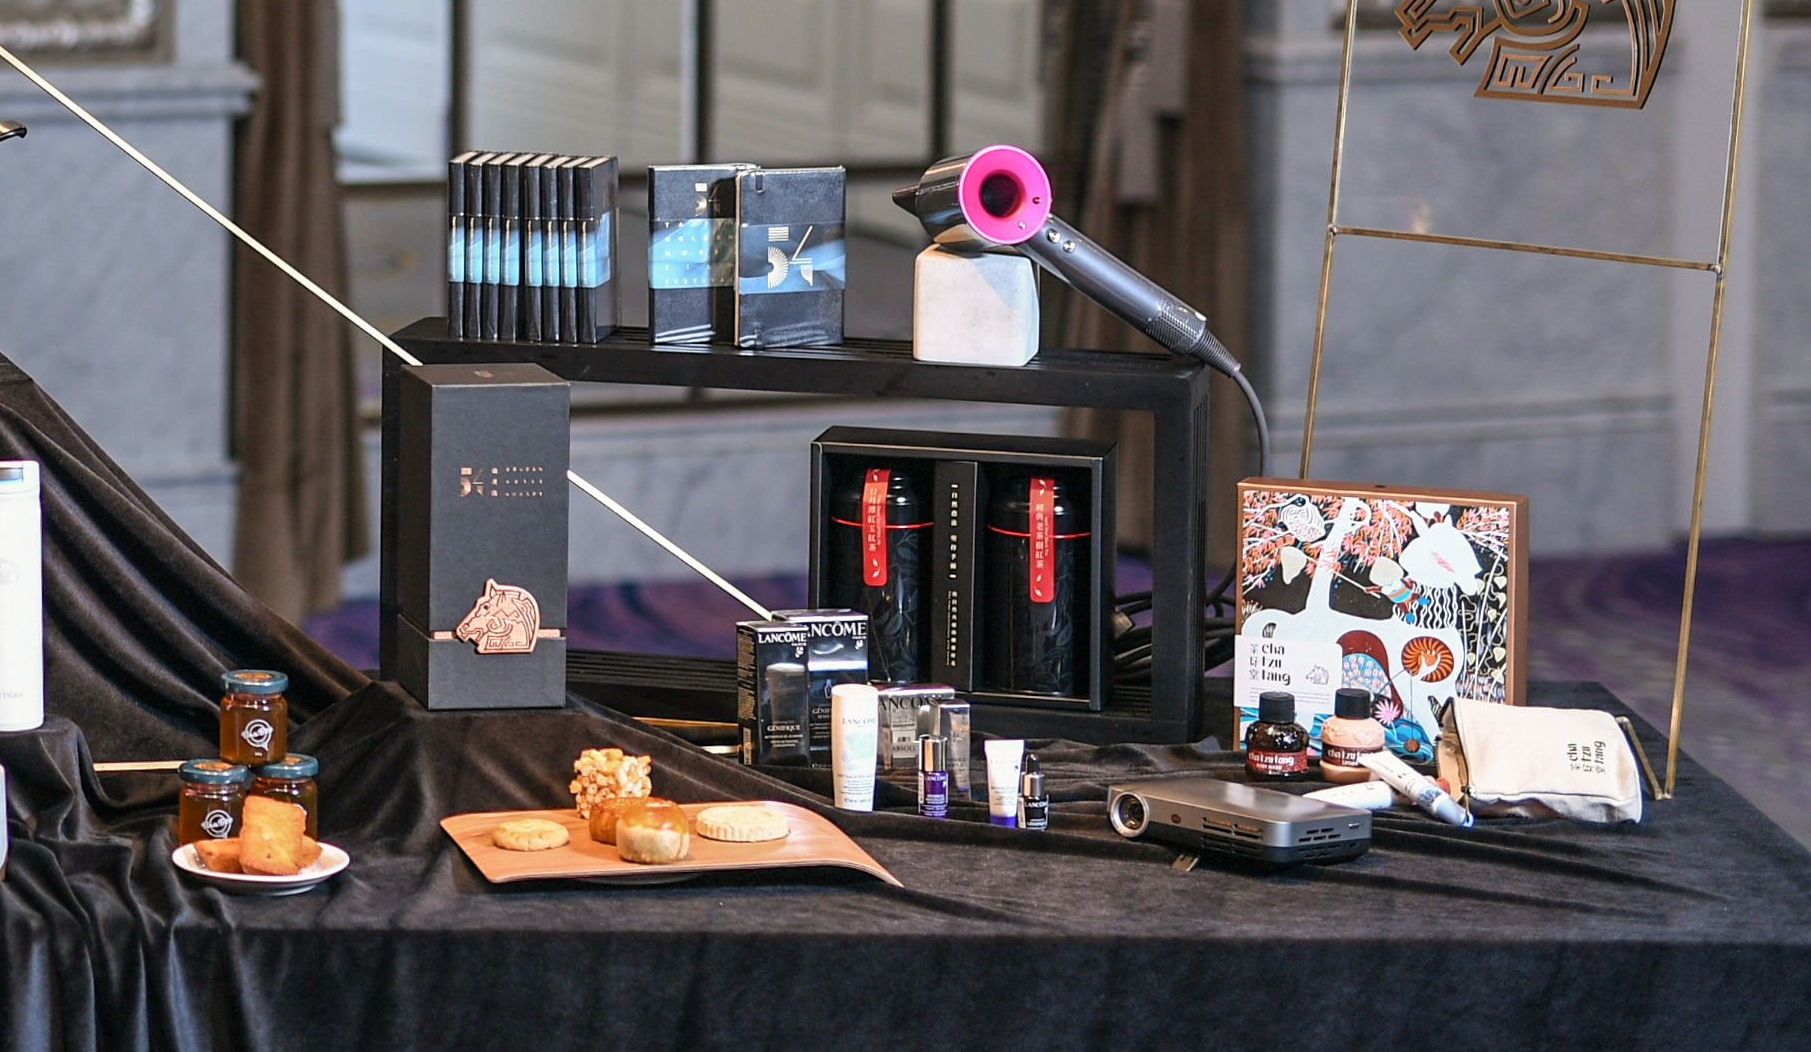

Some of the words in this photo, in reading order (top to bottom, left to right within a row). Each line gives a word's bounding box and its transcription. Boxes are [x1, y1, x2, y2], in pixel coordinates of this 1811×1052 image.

[807, 620, 867, 638] NCÔME
[758, 632, 807, 644] LANCÔME
[1262, 643, 1285, 655] cha
[1262, 669, 1291, 686] tang
